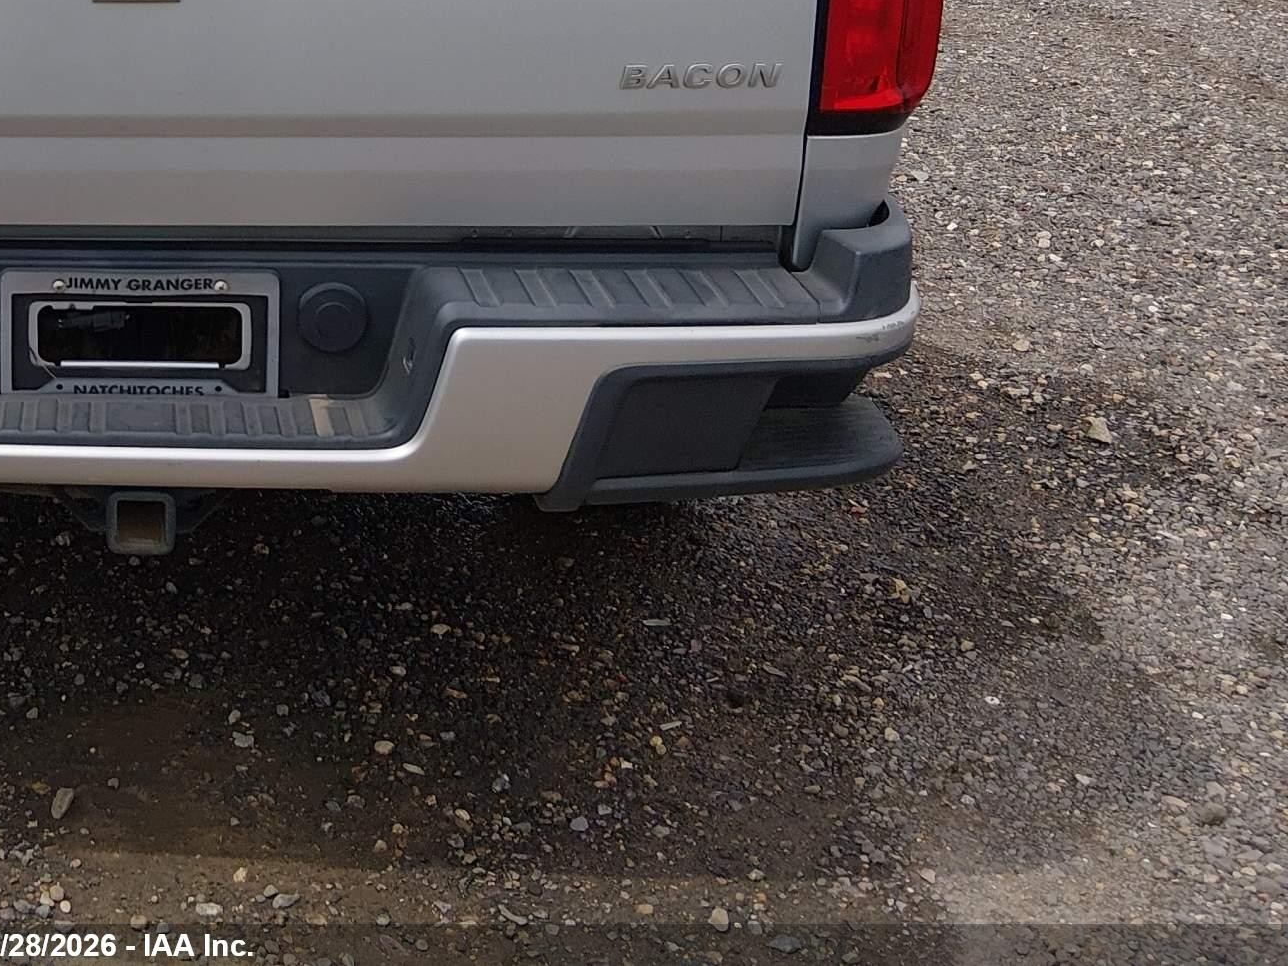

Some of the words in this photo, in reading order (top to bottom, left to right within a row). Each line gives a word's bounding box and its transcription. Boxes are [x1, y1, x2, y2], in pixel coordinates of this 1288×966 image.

[619, 62, 784, 90] BACON
[64, 277, 122, 291] JIMMY
[125, 277, 213, 291] GRANGER
